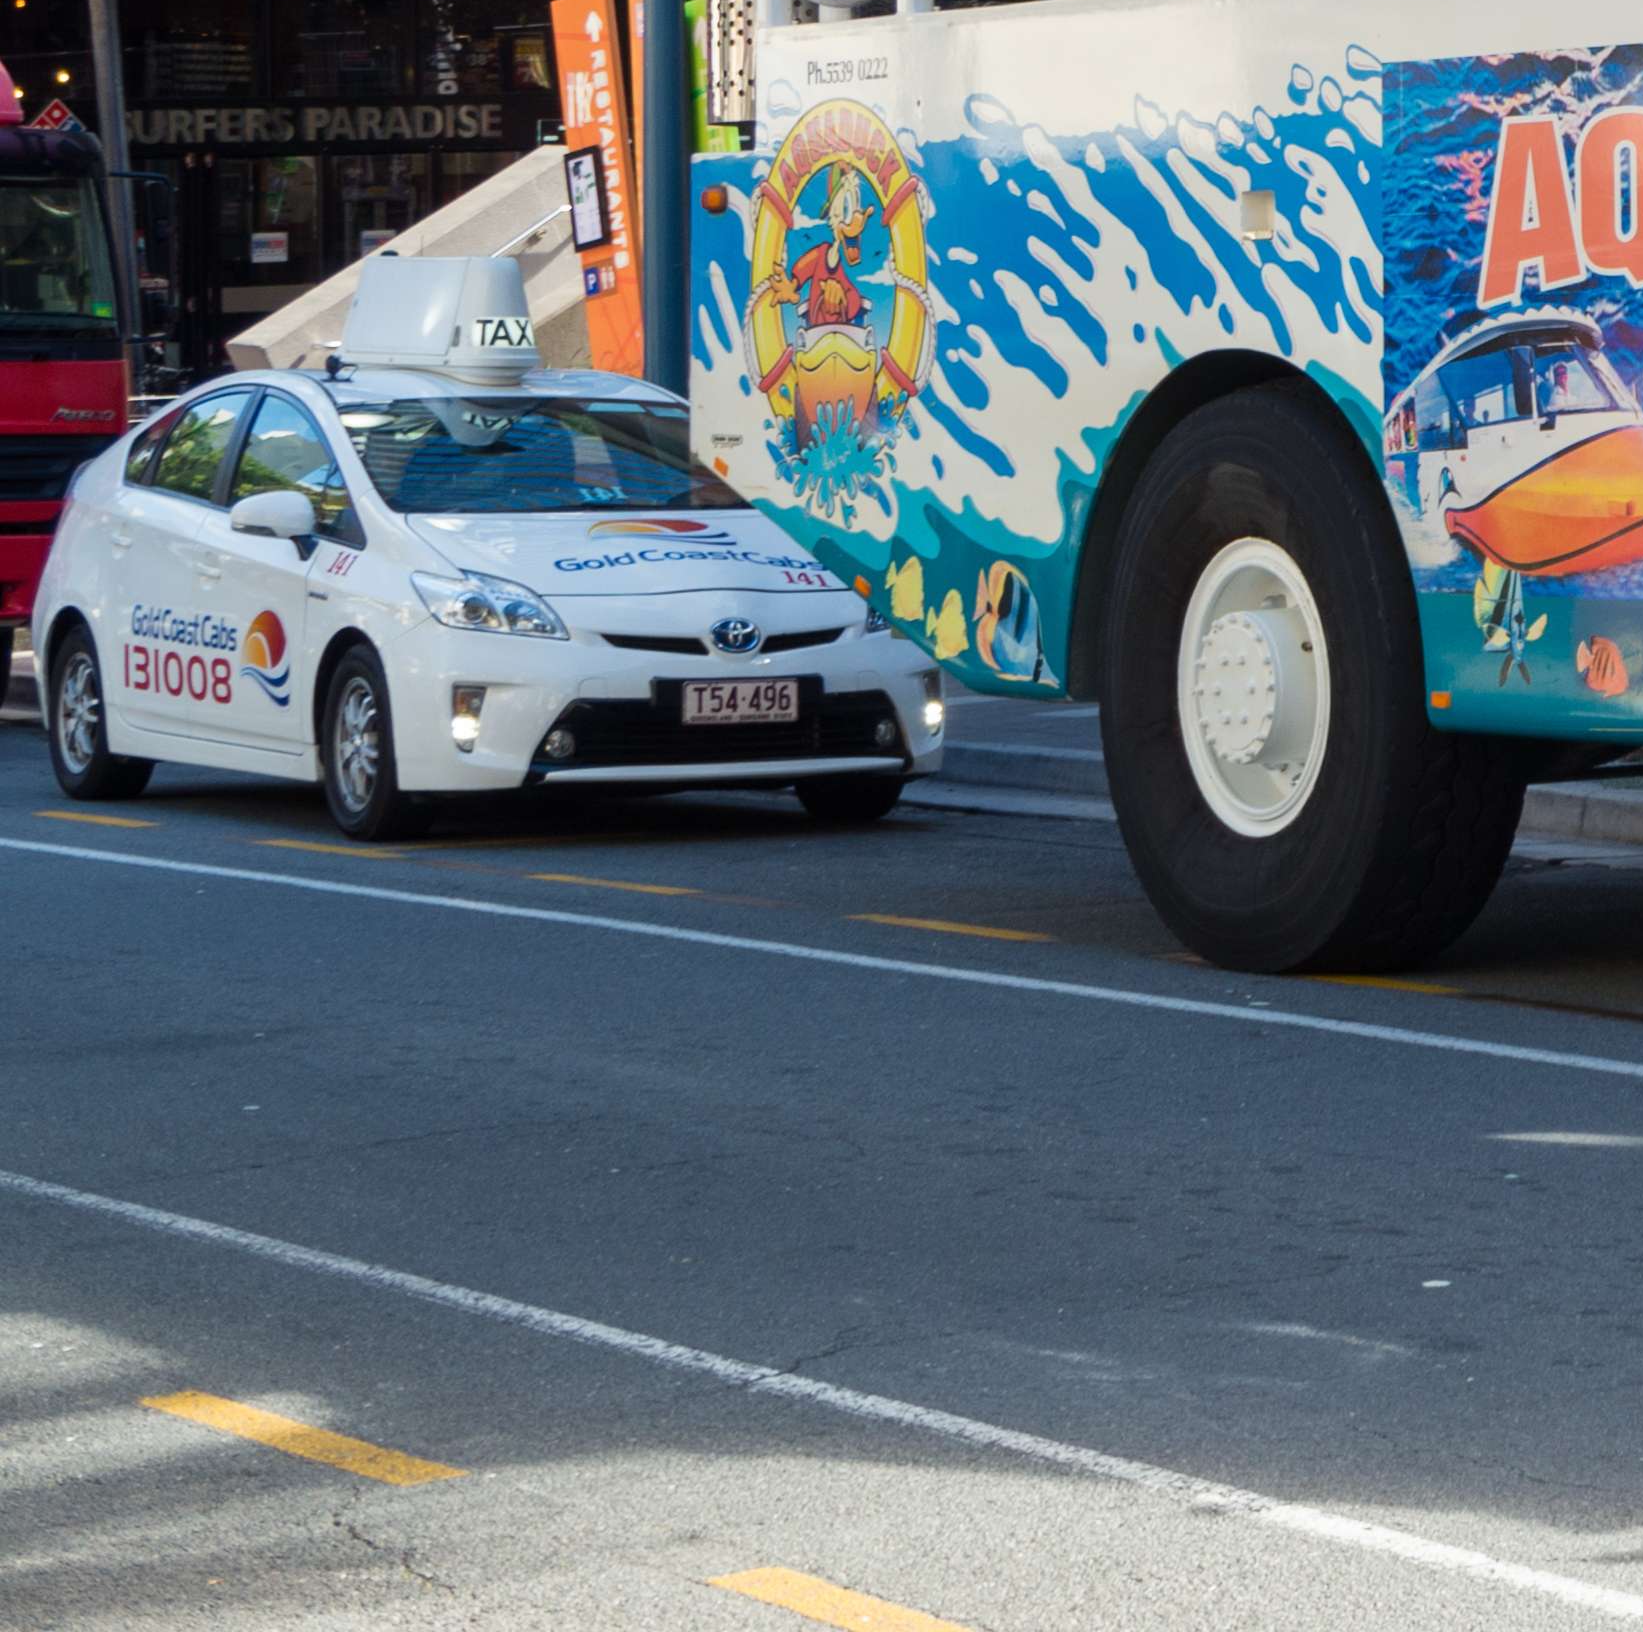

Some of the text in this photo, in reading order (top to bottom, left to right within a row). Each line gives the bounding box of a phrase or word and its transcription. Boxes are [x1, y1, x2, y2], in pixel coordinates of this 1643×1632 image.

[857, 57, 888, 81] 0222
[304, 104, 503, 141] PARADISE
[589, 49, 630, 270] RESTAURANTS
[326, 551, 360, 577] 141
[782, 570, 830, 588] 141
[131, 604, 238, 652] Gold Coast Cabs
[123, 642, 233, 705] 131008
